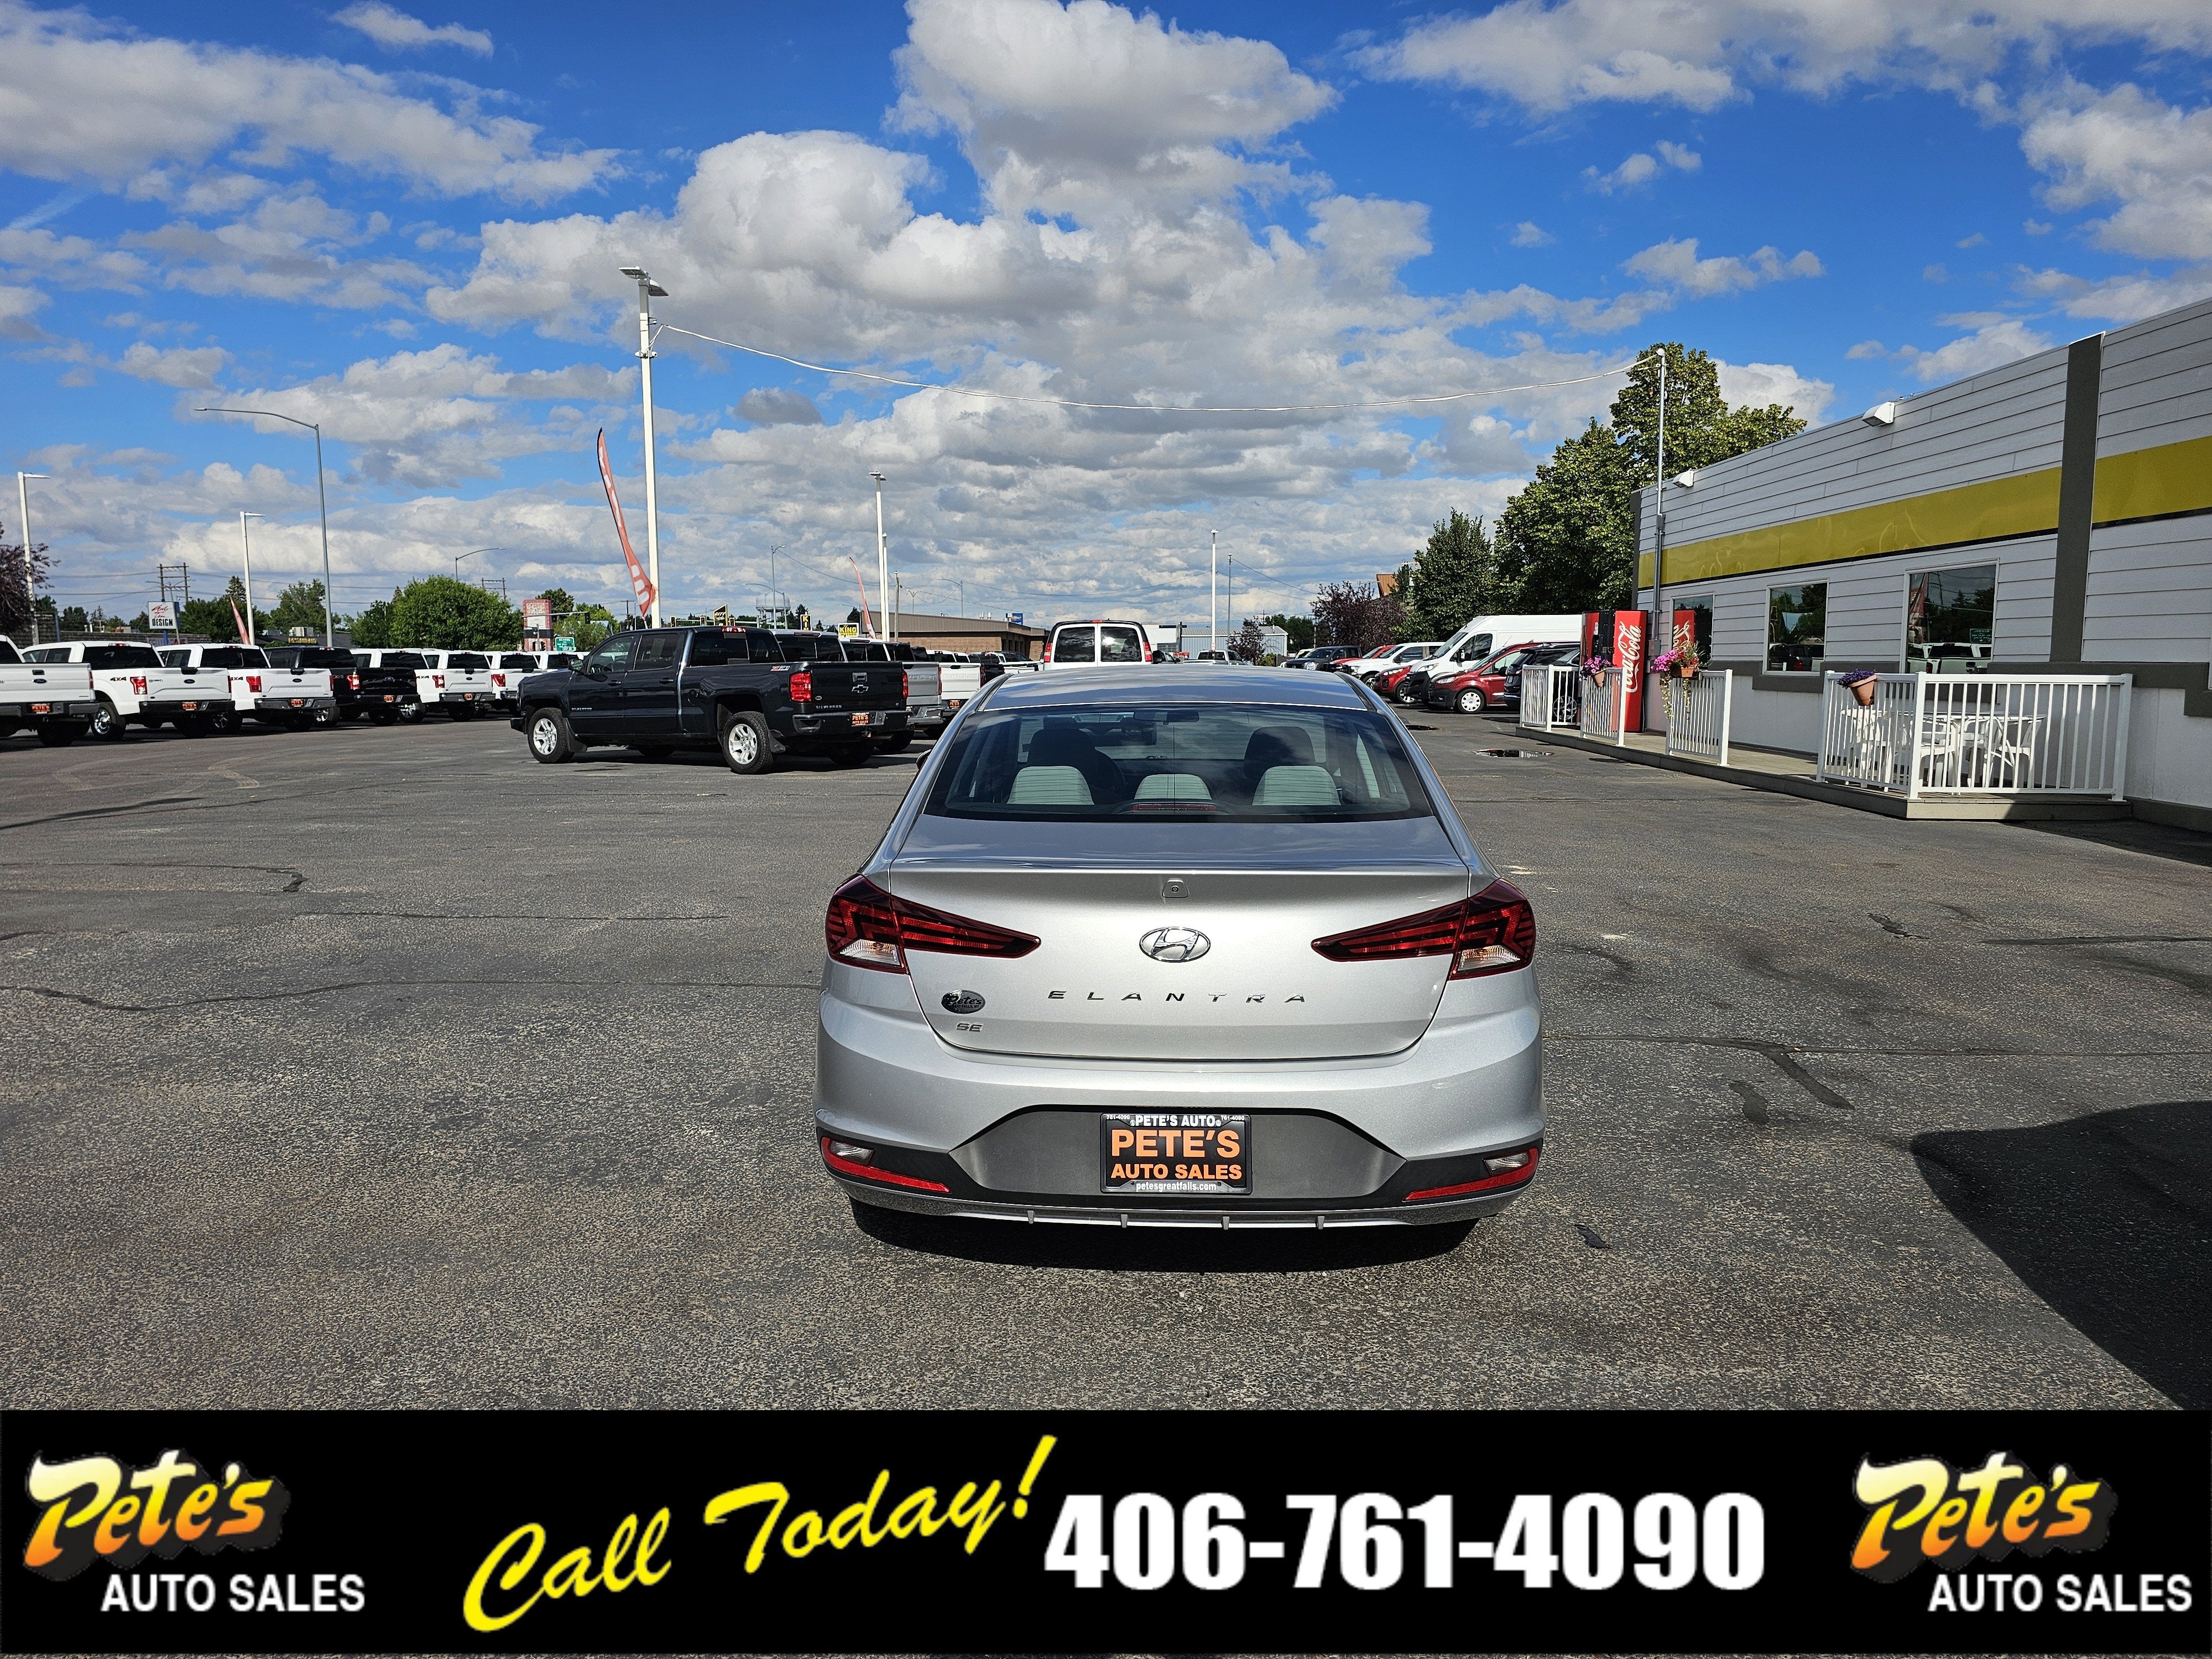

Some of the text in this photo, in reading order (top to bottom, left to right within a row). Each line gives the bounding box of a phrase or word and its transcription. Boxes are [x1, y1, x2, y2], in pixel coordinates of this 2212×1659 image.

[1047, 990, 1306, 1003] ELANTRA
[956, 1022, 983, 1032] SE
[1135, 1115, 1215, 1127] PETE'S AUTO
[1112, 1129, 1240, 1157] PETE'S
[1110, 1164, 1242, 1180] AUTO SALES
[1135, 1181, 1217, 1192] petesgreatfalls.com
